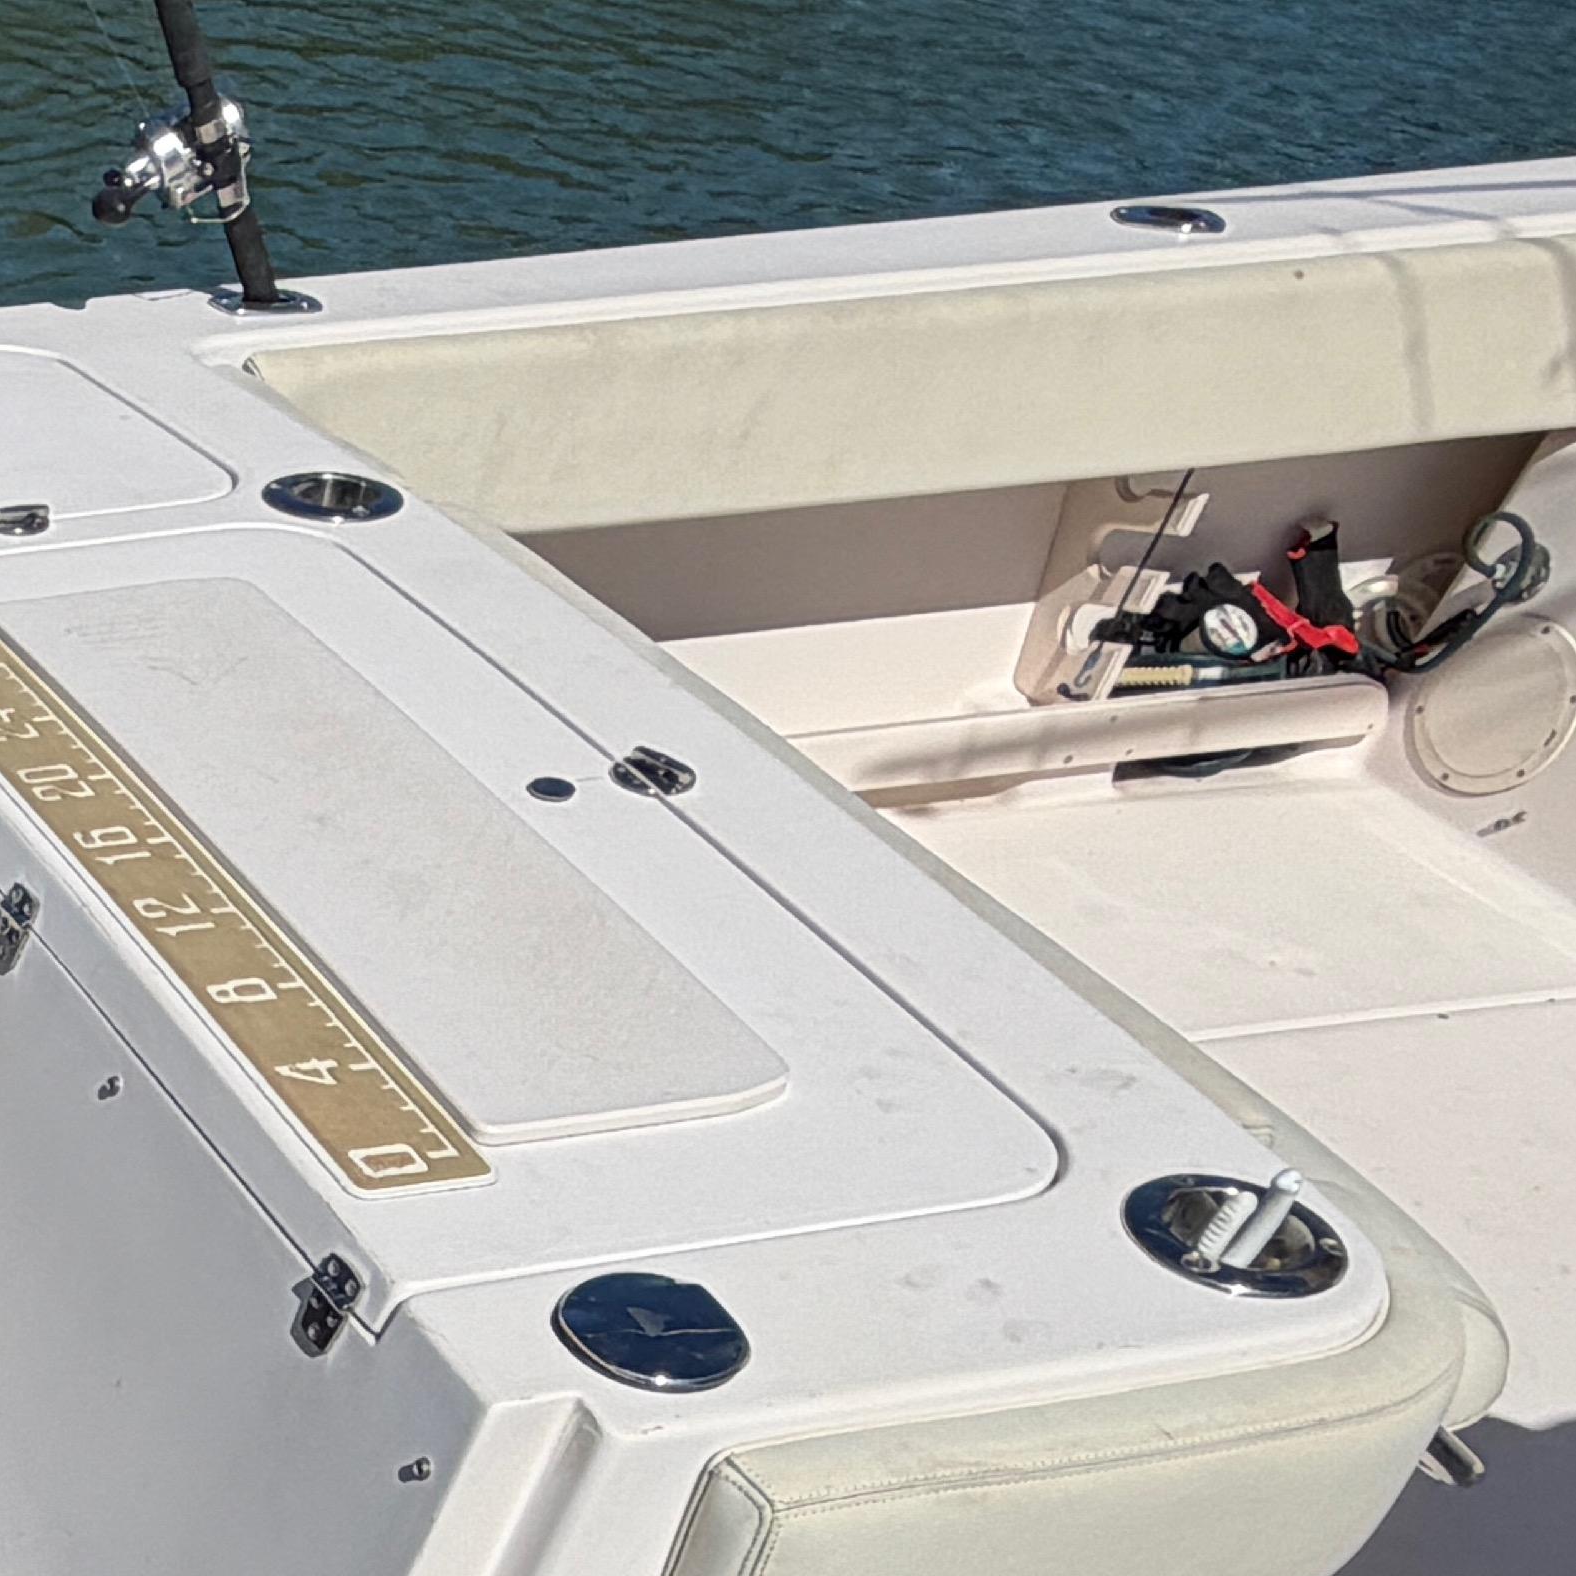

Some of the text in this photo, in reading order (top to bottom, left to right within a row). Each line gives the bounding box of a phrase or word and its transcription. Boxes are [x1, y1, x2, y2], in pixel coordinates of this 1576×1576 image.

[15, 763, 96, 801] 20
[72, 826, 152, 865] 16
[132, 892, 216, 936] 12
[205, 977, 278, 1004] 8
[273, 1057, 339, 1085] 4
[347, 1143, 429, 1178] 0
